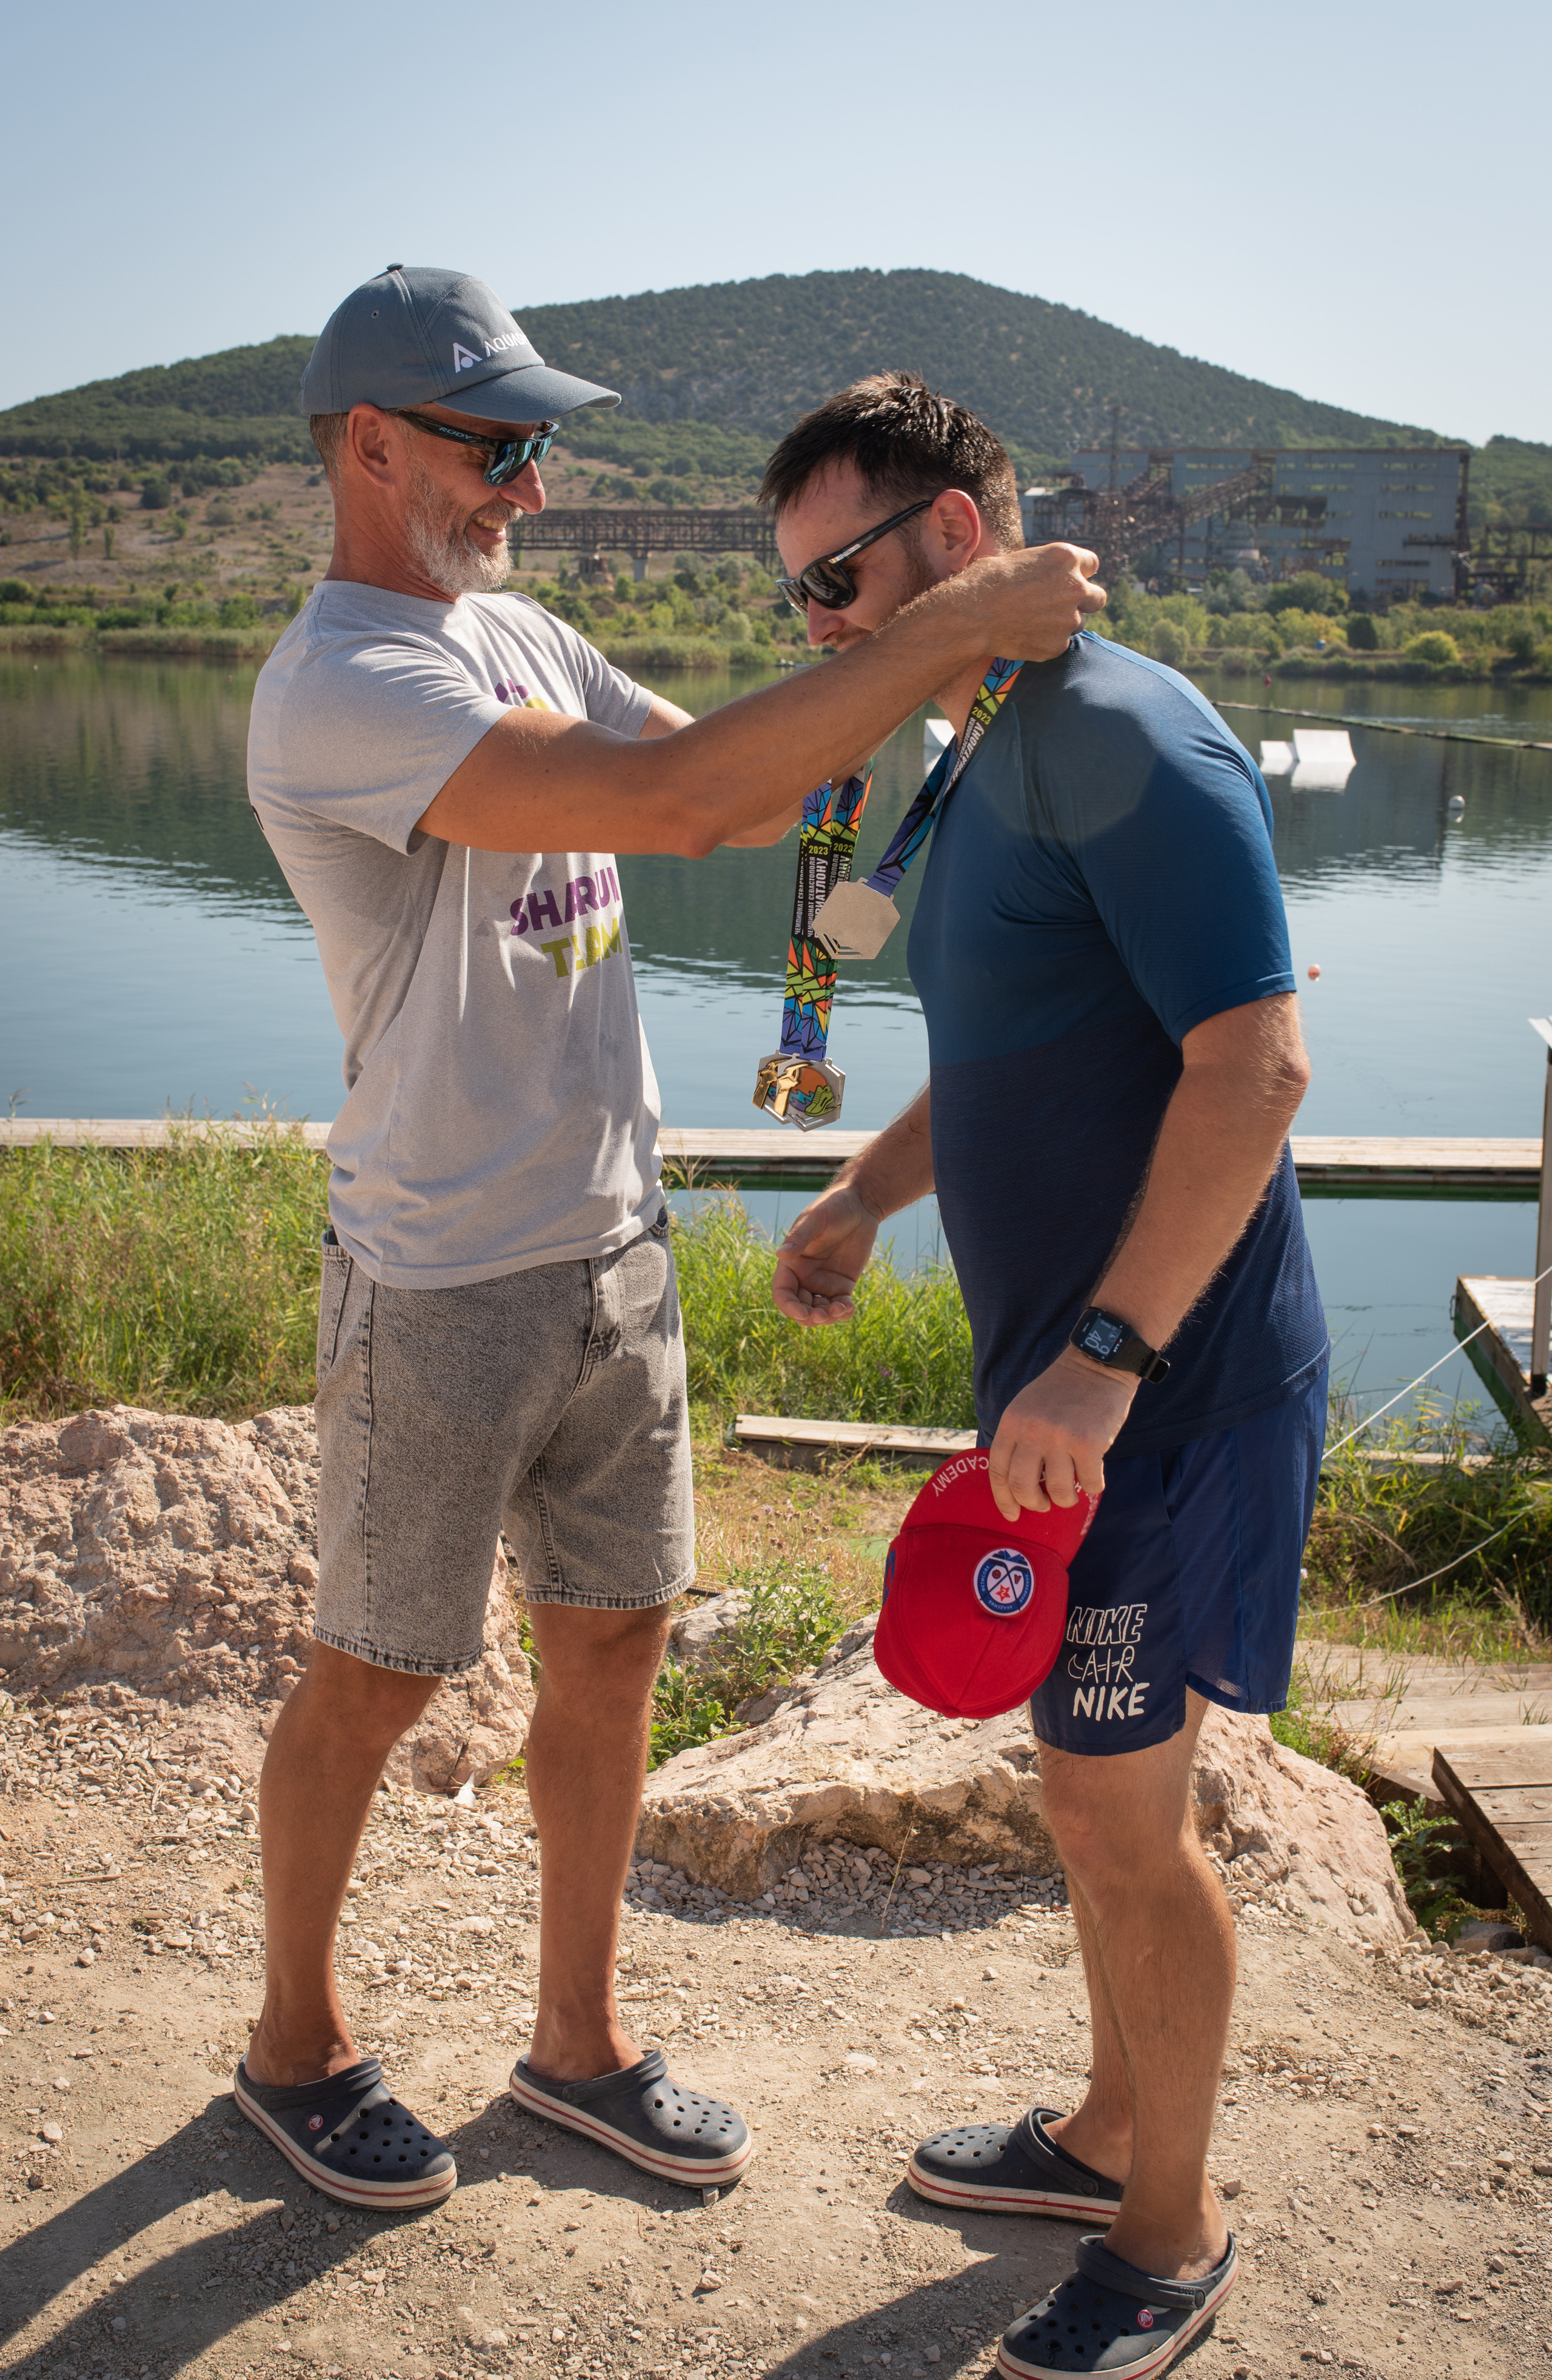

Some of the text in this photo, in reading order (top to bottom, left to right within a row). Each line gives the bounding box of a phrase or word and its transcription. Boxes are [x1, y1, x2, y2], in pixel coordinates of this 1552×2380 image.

[439, 426, 473, 440] RUDY
[972, 706, 992, 725] 2023
[952, 721, 985, 782] ТРИАТЛОНУ
[809, 845, 828, 855] 2023
[834, 843, 853, 854] 2023
[815, 858, 828, 918] РИАТЛОНУ
[795, 900, 804, 935] ЧЕМПИОНАТ
[1085, 1330, 1102, 1348] 40
[1097, 1345, 1109, 1354] 9
[932, 1456, 989, 1497] CADEMY
[980, 1565, 990, 1592] ФЕТИСОВА
[988, 1599, 1013, 1610] АКАДЕМИЯ
[1066, 1603, 1148, 1645] NIKE
[1082, 1645, 1135, 1683] AIR
[1073, 1682, 1150, 1721] NIKE
